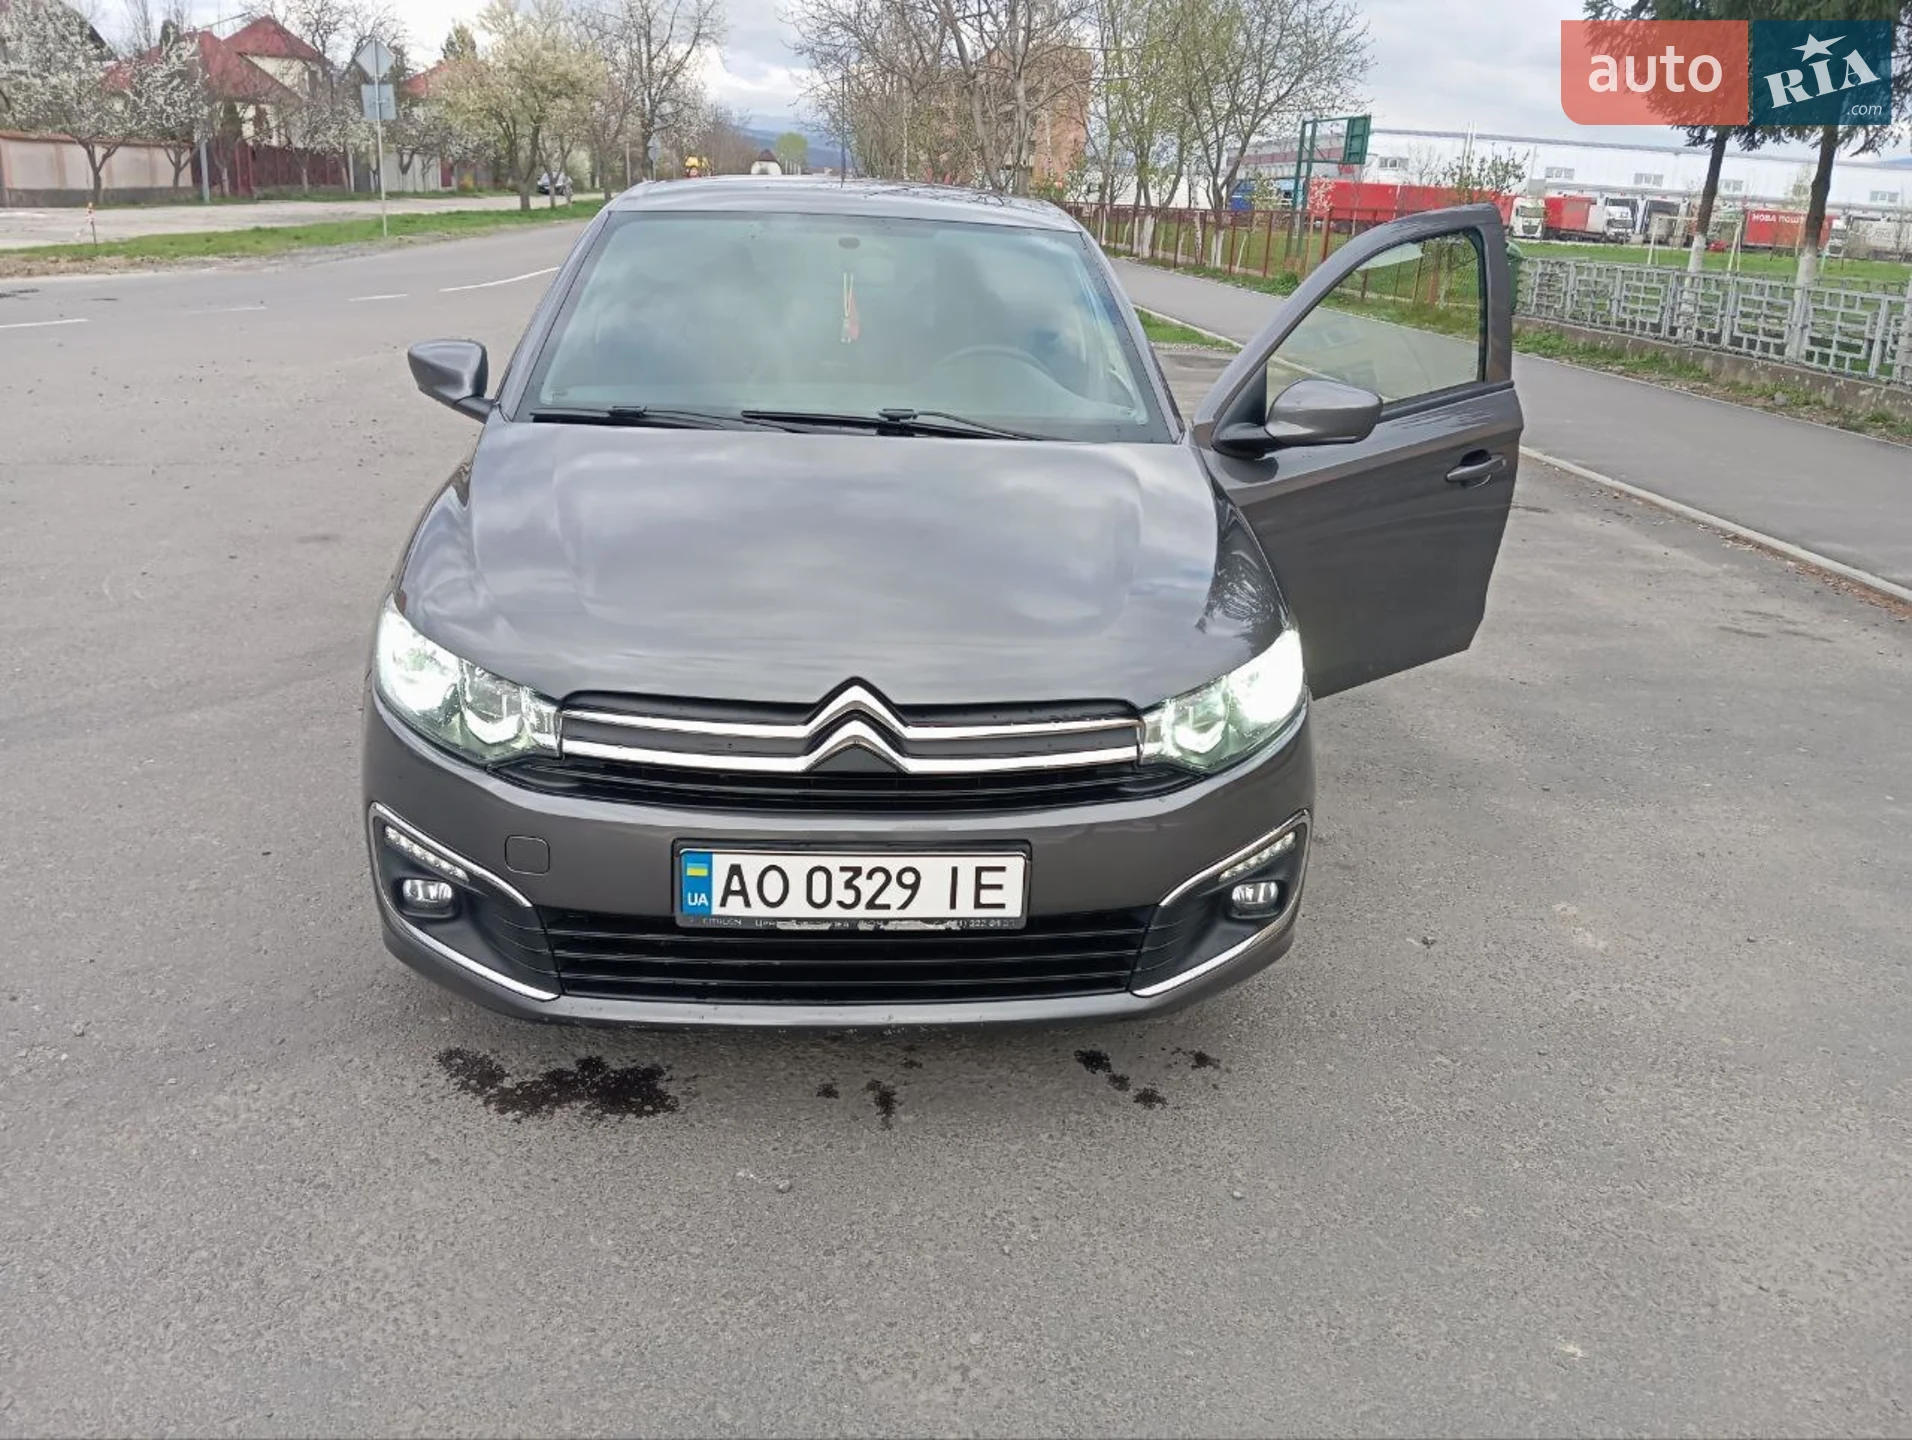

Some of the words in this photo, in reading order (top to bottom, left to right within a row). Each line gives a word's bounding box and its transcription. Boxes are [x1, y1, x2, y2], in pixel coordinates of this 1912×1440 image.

[687, 892, 709, 906] UA
[719, 863, 790, 909] AO
[805, 865, 922, 911] 0329
[949, 866, 1007, 910] IE
